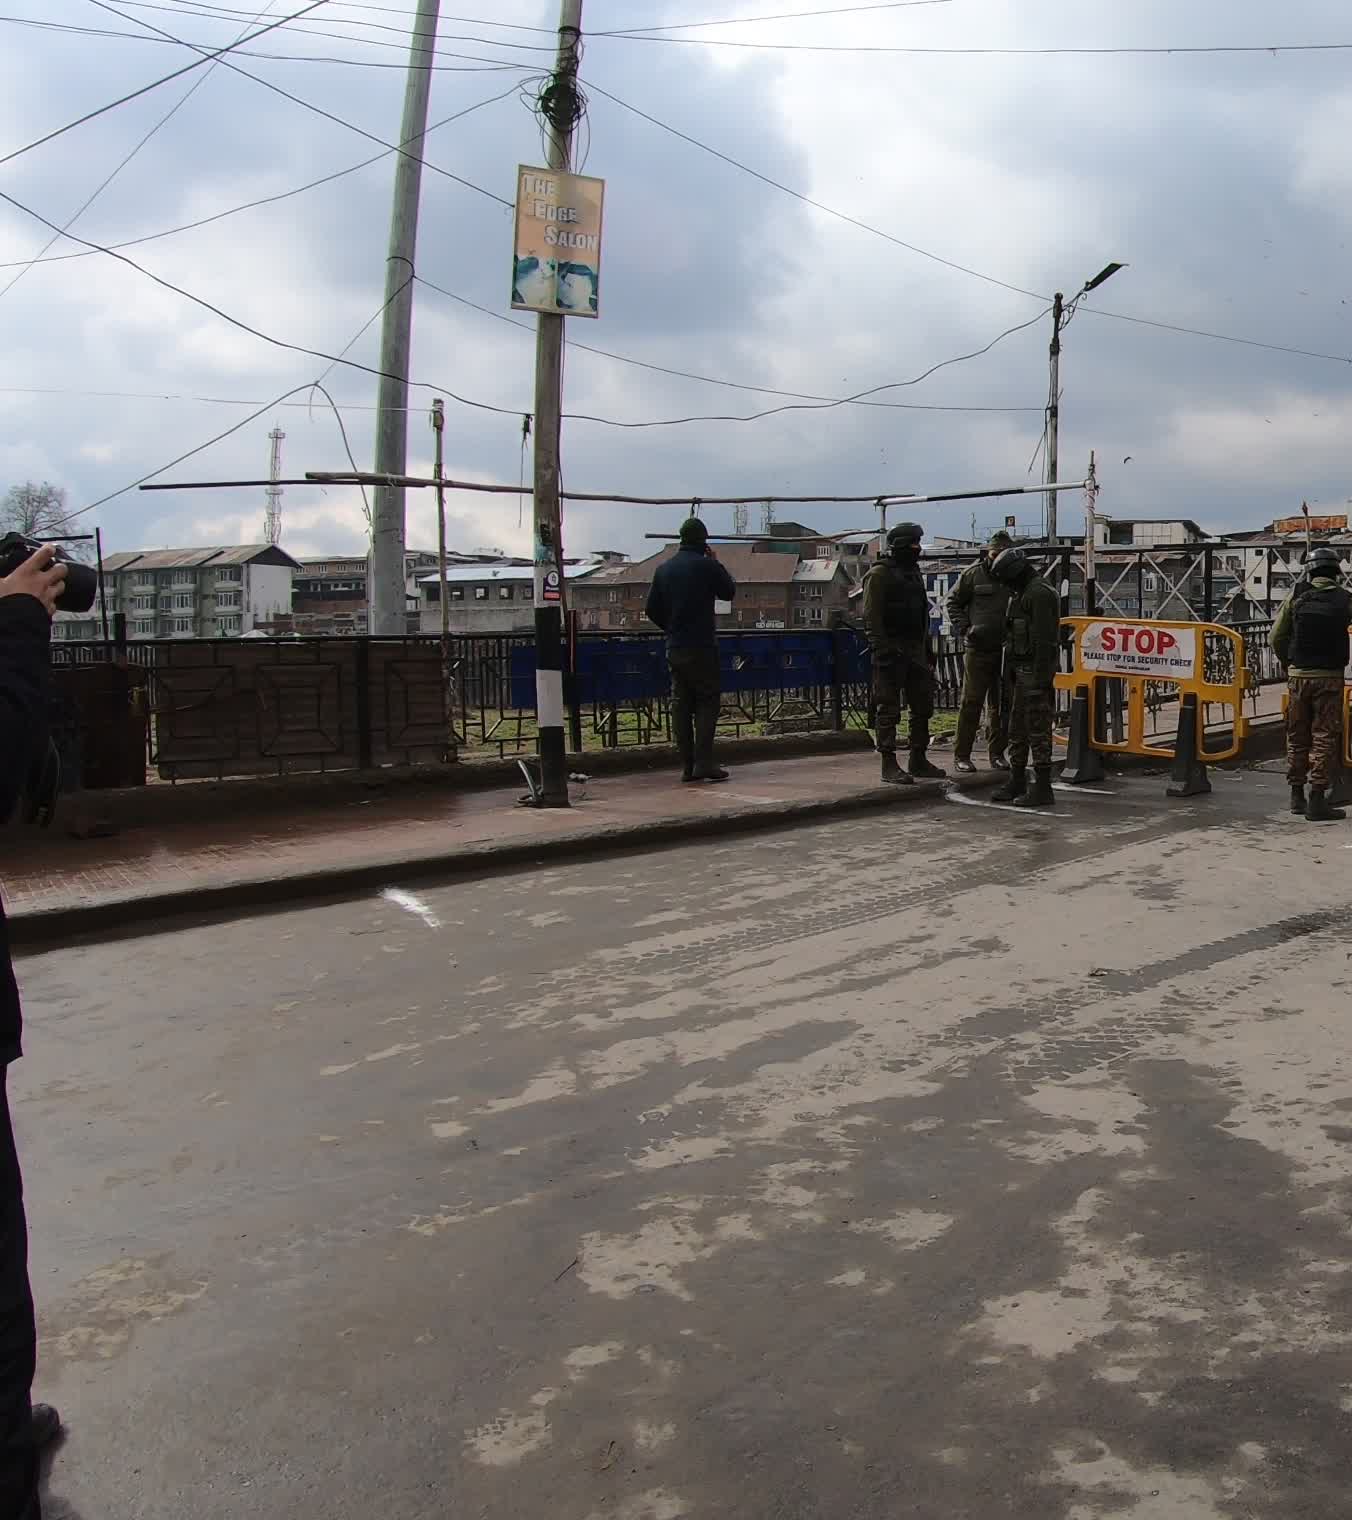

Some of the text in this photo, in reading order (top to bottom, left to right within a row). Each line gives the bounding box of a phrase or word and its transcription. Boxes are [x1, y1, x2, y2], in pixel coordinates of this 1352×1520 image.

[523, 174, 555, 197] THE
[534, 199, 577, 222] EDGE
[544, 224, 598, 251] SALON
[1101, 627, 1175, 655] STOP
[1083, 651, 1192, 667] PLEASE STOP FOR SECURITY CHECK
